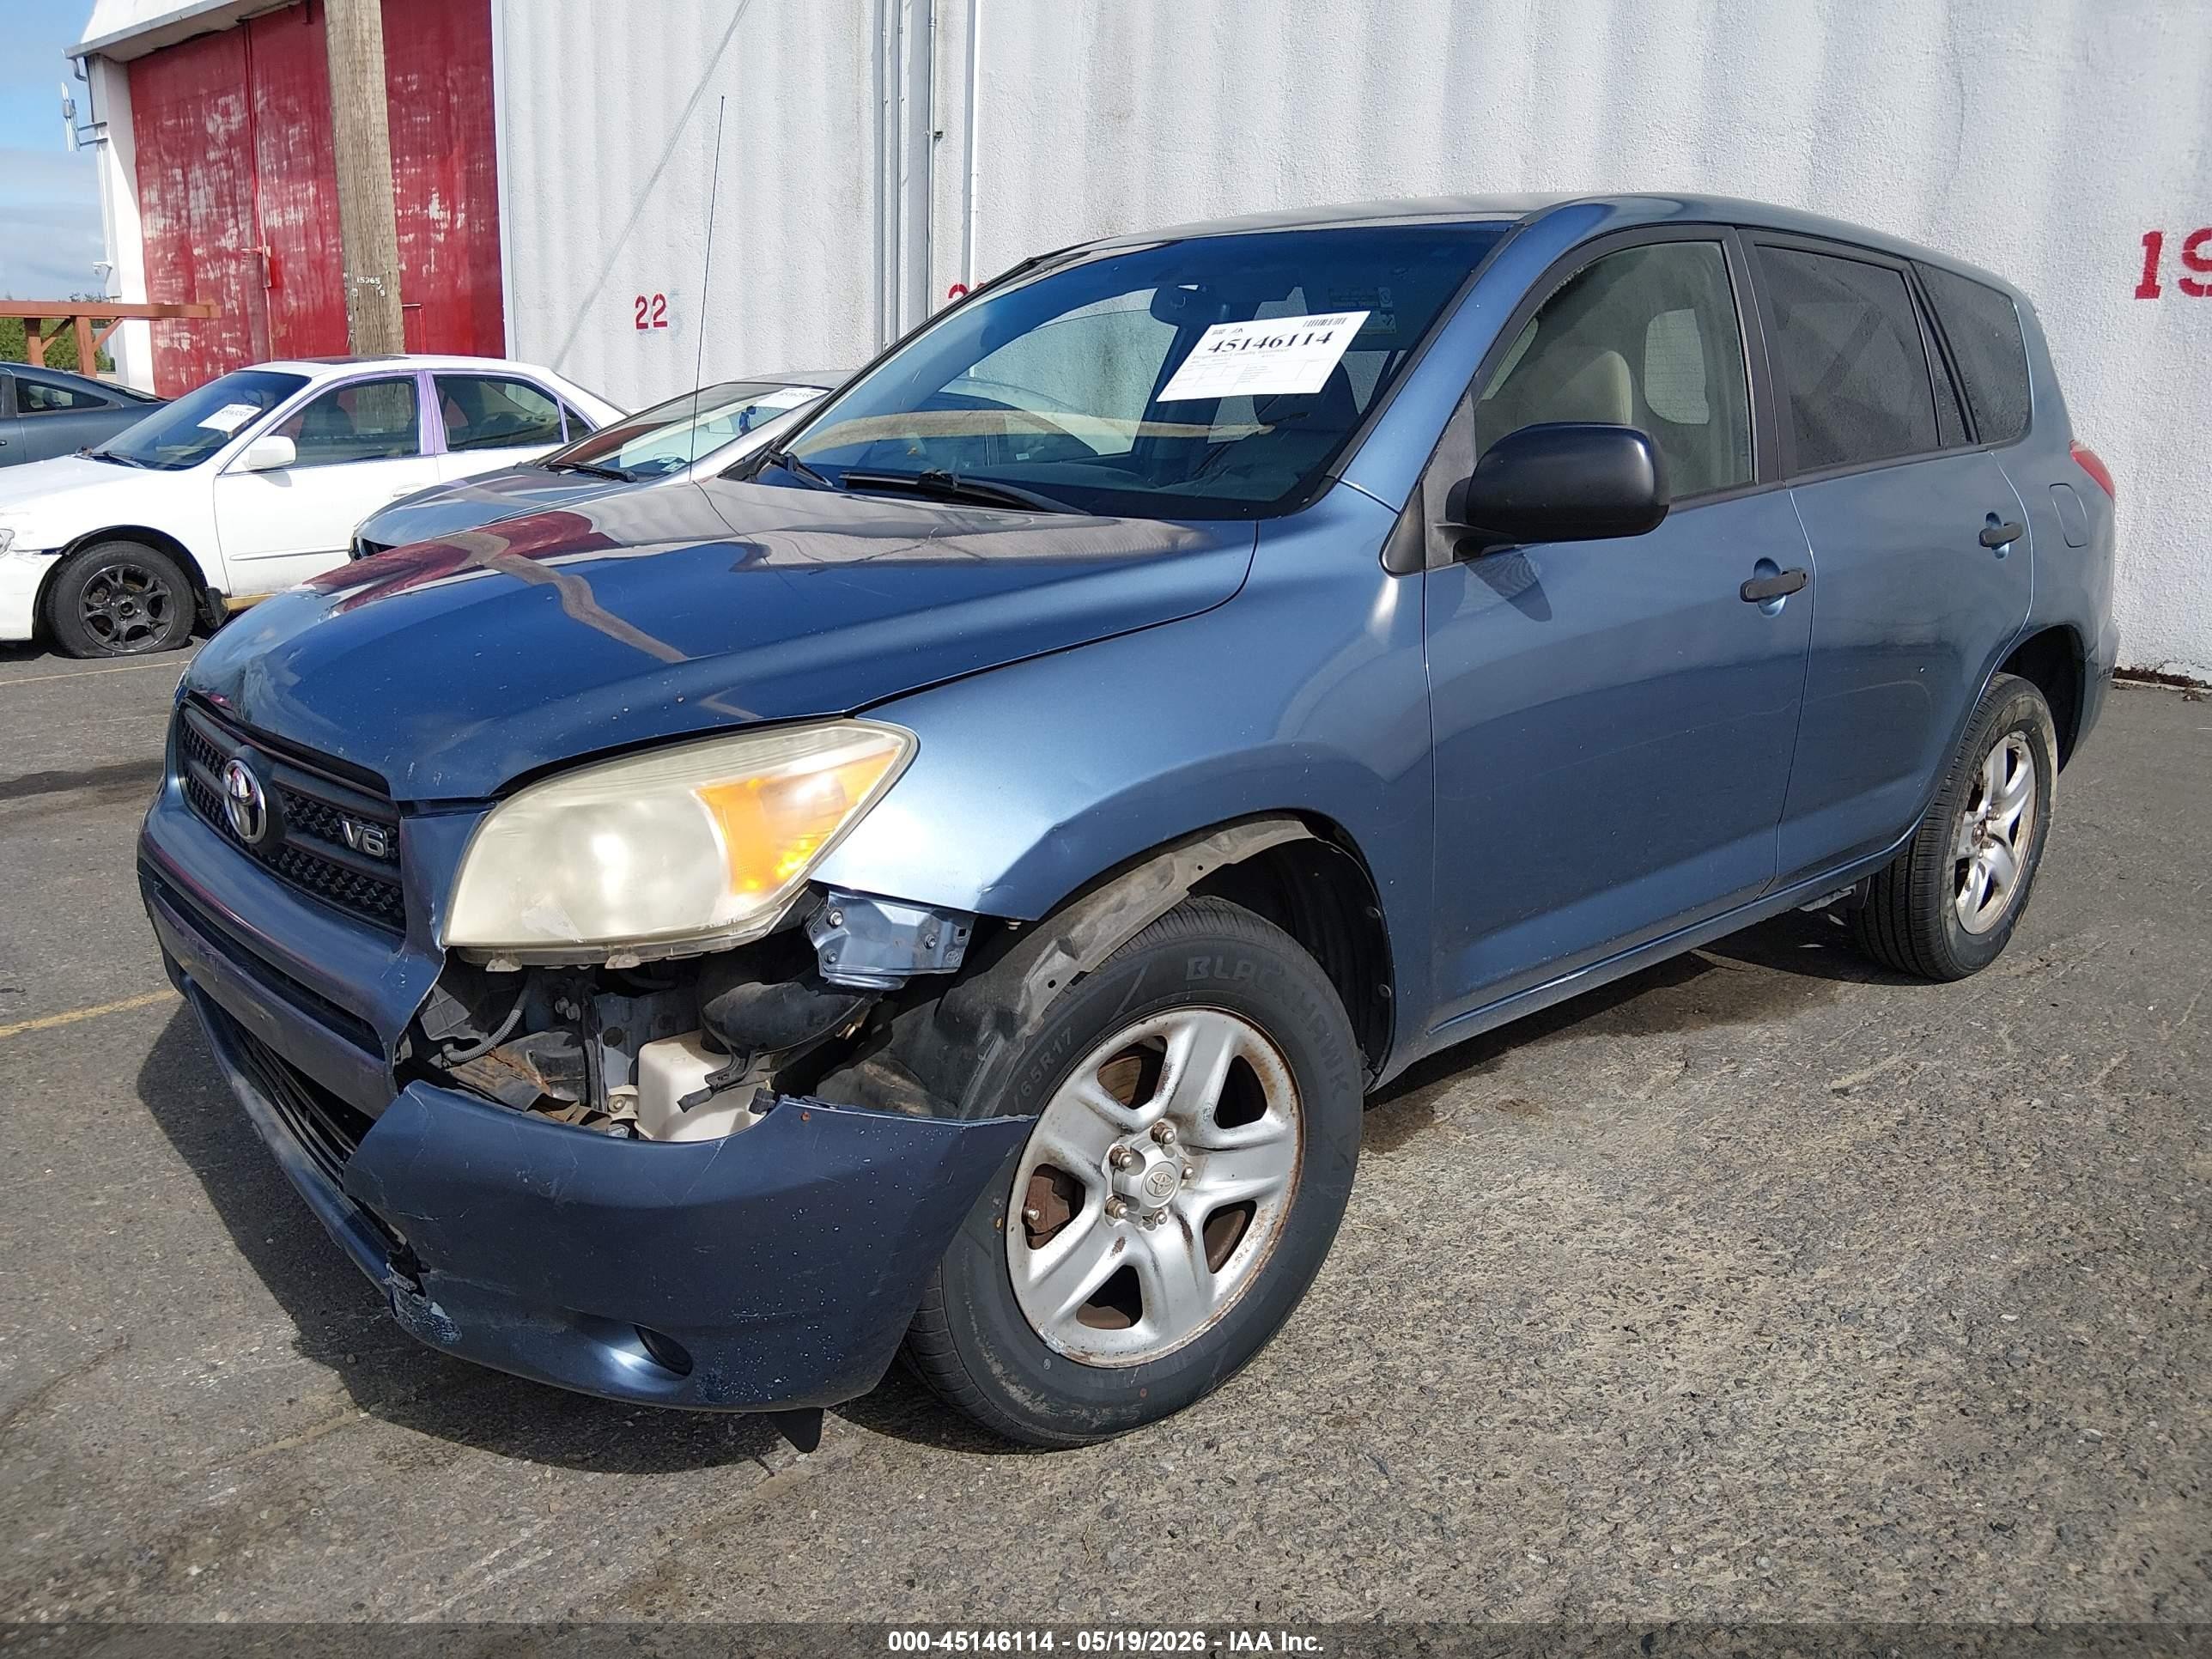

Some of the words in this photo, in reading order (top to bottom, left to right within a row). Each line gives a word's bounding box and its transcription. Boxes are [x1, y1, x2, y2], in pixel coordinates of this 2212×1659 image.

[635, 293, 668, 330] 22
[1207, 331, 1334, 353] 45146114
[342, 820, 385, 857] V6
